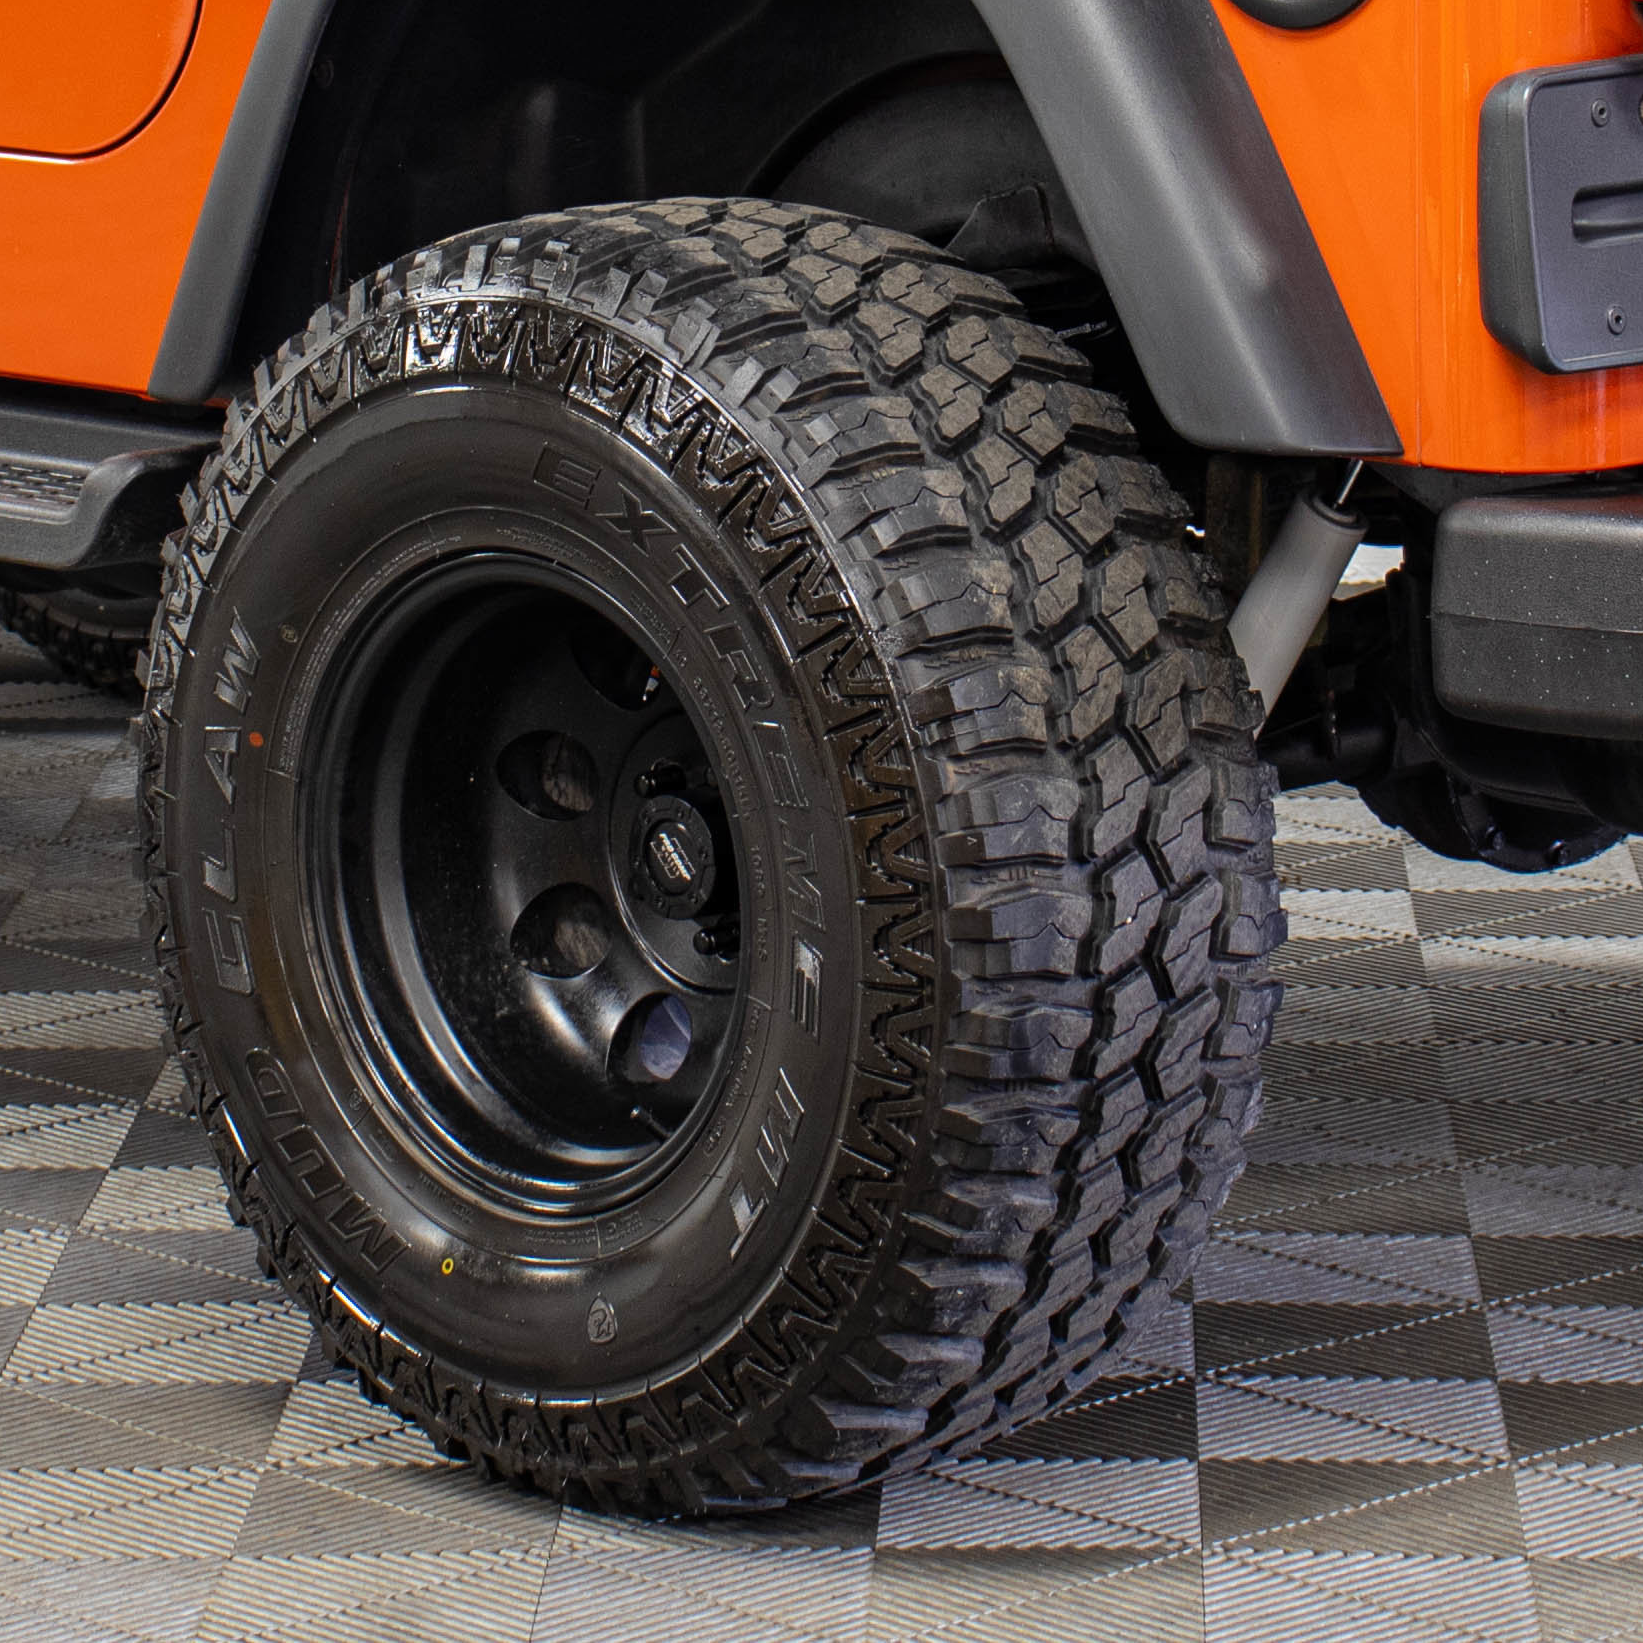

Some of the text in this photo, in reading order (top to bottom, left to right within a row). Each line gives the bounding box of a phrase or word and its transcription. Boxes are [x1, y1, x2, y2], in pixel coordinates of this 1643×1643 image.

[201, 606, 259, 995] CLAW
[531, 443, 826, 1045] EXTREME
[245, 1047, 412, 1274] MUD
